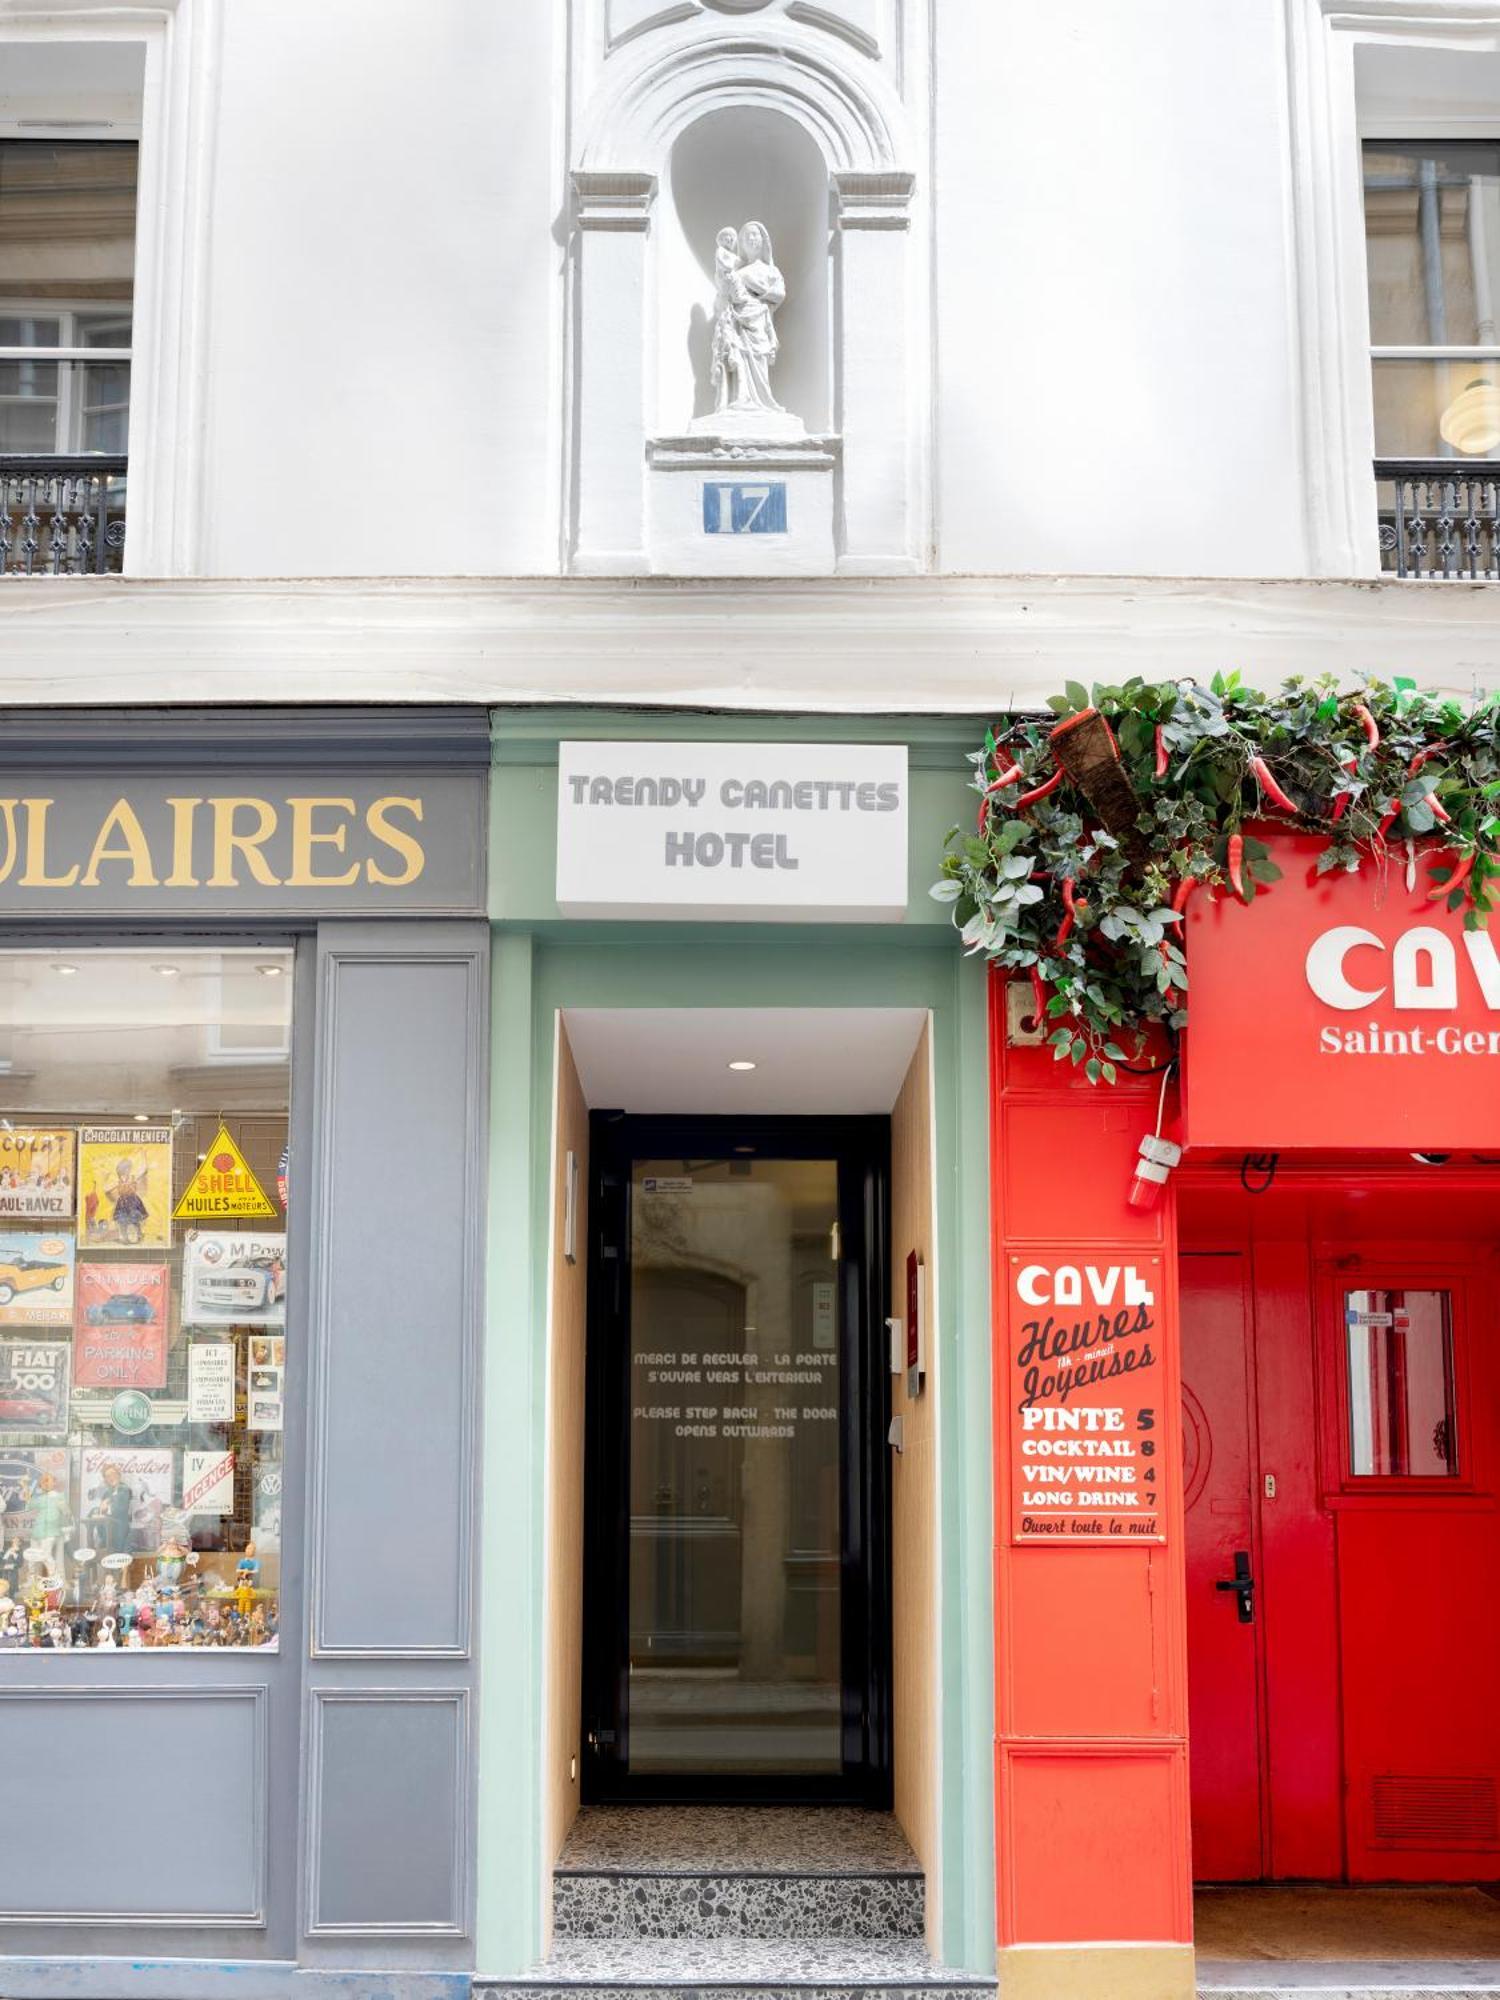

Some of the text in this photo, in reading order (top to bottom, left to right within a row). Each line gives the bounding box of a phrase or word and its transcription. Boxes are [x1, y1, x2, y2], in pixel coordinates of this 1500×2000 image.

[718, 487, 770, 533] 17
[568, 775, 899, 811] TRENDY CANETTES
[664, 831, 799, 870] HOTEL
[84, 1130, 168, 1142] CHOCOLAT MENIER
[198, 1174, 255, 1193] SHELL
[186, 1197, 229, 1211] HUILES
[1017, 1302, 1154, 1367] Heures
[12, 1351, 58, 1367] FIAT
[634, 1353, 676, 1365] MERCI
[682, 1354, 697, 1365] DE
[703, 1354, 758, 1365] RECULER
[774, 1354, 790, 1365] LA
[796, 1354, 837, 1365] PORTE
[648, 1372, 701, 1383] S'OUVRE
[706, 1372, 739, 1383] VERS
[1018, 1344, 1156, 1413] Joyeuses
[633, 1408, 680, 1419] PLEASE
[686, 1408, 717, 1419] STEP
[723, 1408, 758, 1419] BACK
[774, 1408, 797, 1419] THE
[803, 1408, 837, 1419] DOOR
[1022, 1408, 1155, 1431] PINTE 5
[675, 1426, 717, 1437] OPENS
[1022, 1440, 1155, 1456] COCKTAIL 8
[192, 1458, 204, 1471] IV
[1022, 1465, 1156, 1484] VIN/WINE 4
[1022, 1492, 1157, 1506] LONG DRINK 7
[1022, 1517, 1157, 1534] Ouvert toute la nuit
